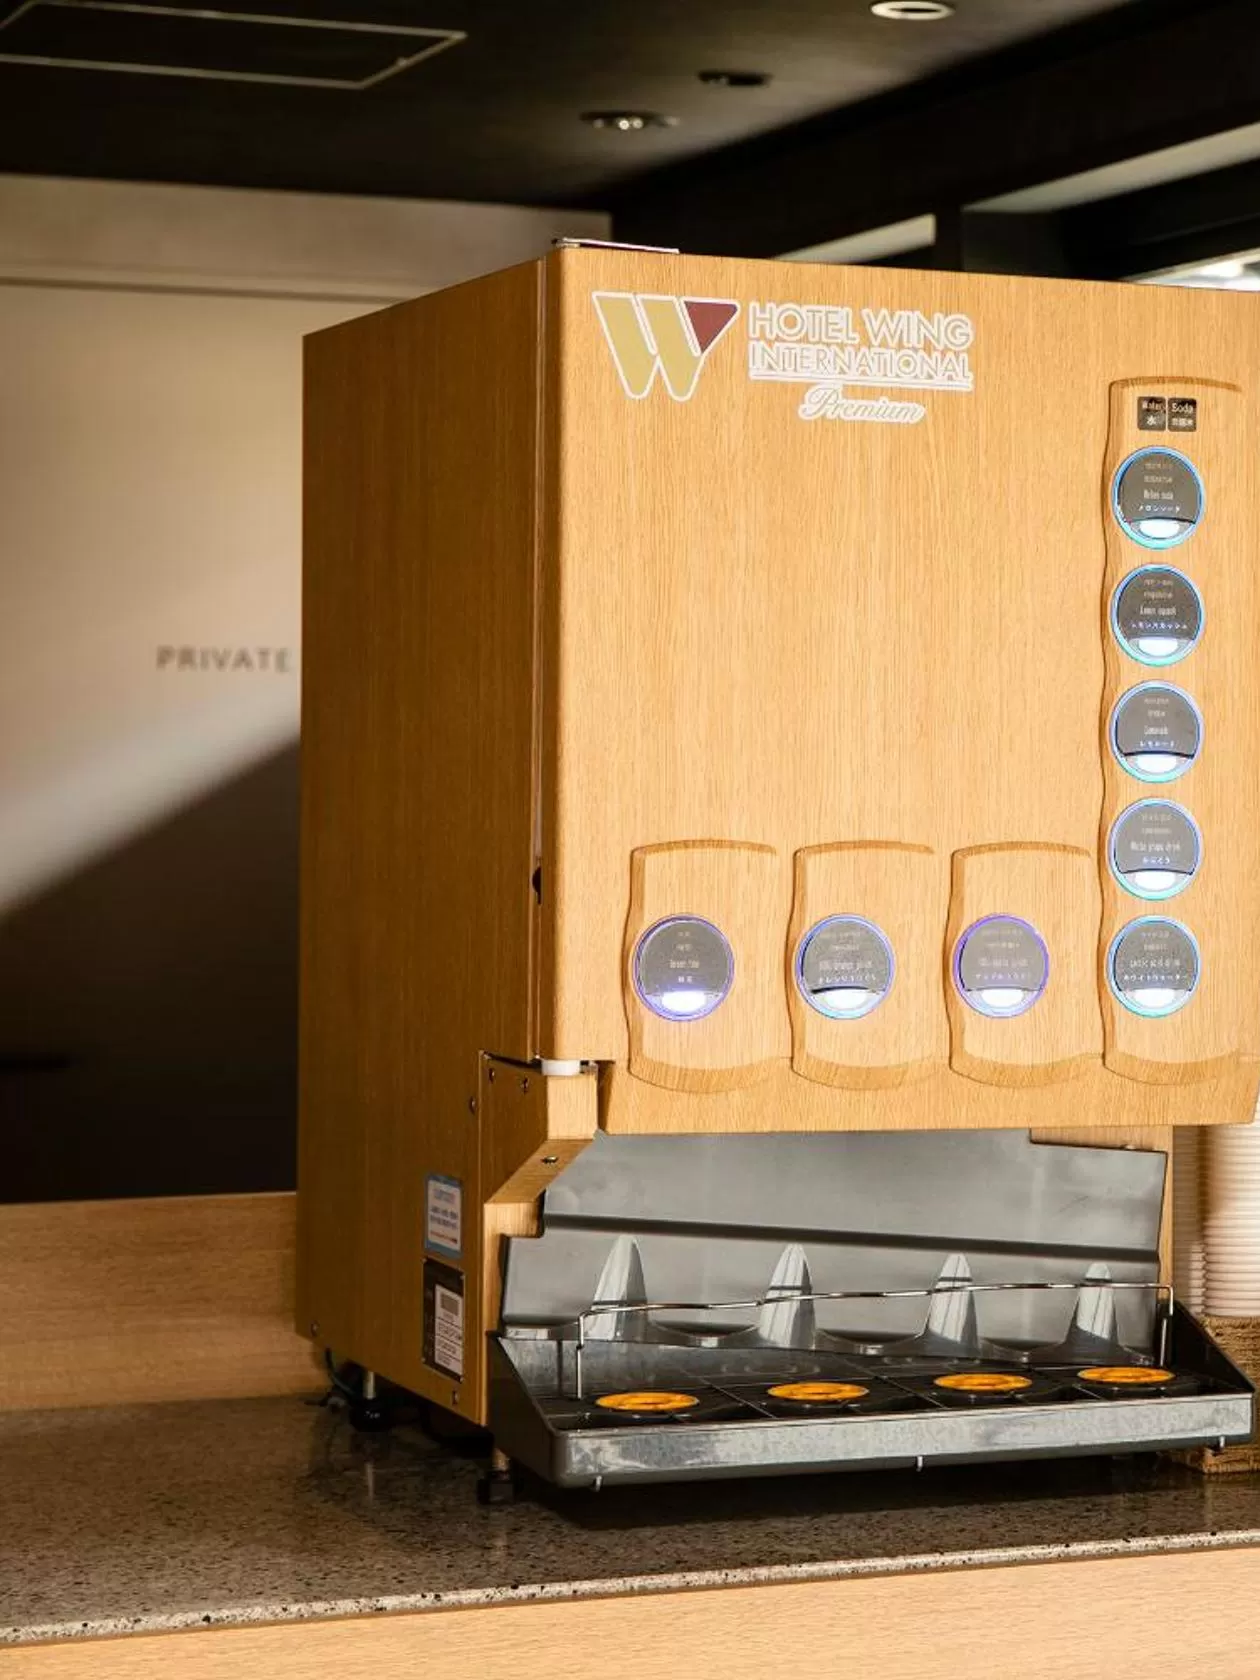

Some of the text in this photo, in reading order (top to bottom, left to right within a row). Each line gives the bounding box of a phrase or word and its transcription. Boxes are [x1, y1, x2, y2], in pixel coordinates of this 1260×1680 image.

[749, 302, 973, 350] HOTEL WING
[749, 344, 972, 382] INTERNATIONAL
[798, 383, 925, 423] Premium
[1171, 402, 1194, 414] Soda
[155, 644, 292, 673] PRIVATE
